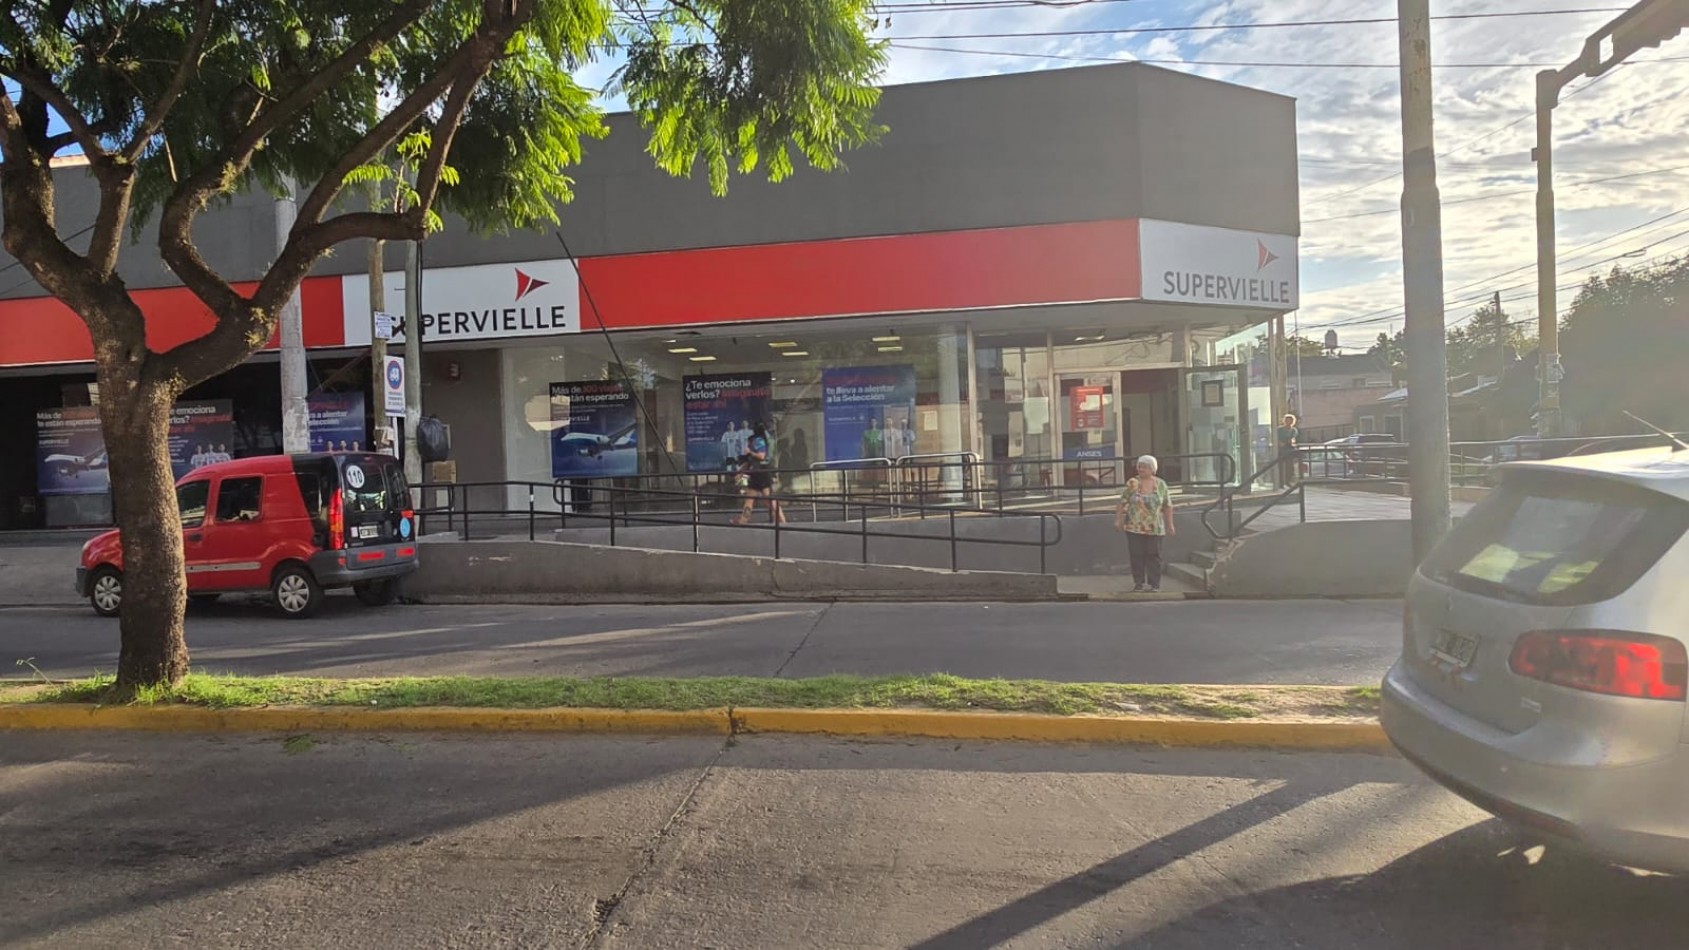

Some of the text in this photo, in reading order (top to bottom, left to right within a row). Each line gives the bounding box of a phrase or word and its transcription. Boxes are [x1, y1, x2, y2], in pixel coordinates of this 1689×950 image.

[1163, 271, 1289, 303] SUPERVIELLE
[552, 386, 569, 394] Más
[571, 385, 581, 393] de
[686, 379, 751, 391] ¿Te emociona
[826, 387, 835, 395] te
[836, 386, 856, 394] lleva
[864, 384, 894, 393] alentar
[585, 393, 629, 402] esperando
[686, 390, 720, 399] verlos?
[842, 393, 885, 401] Selección
[176, 405, 216, 414] emociona
[349, 470, 363, 484] 110
